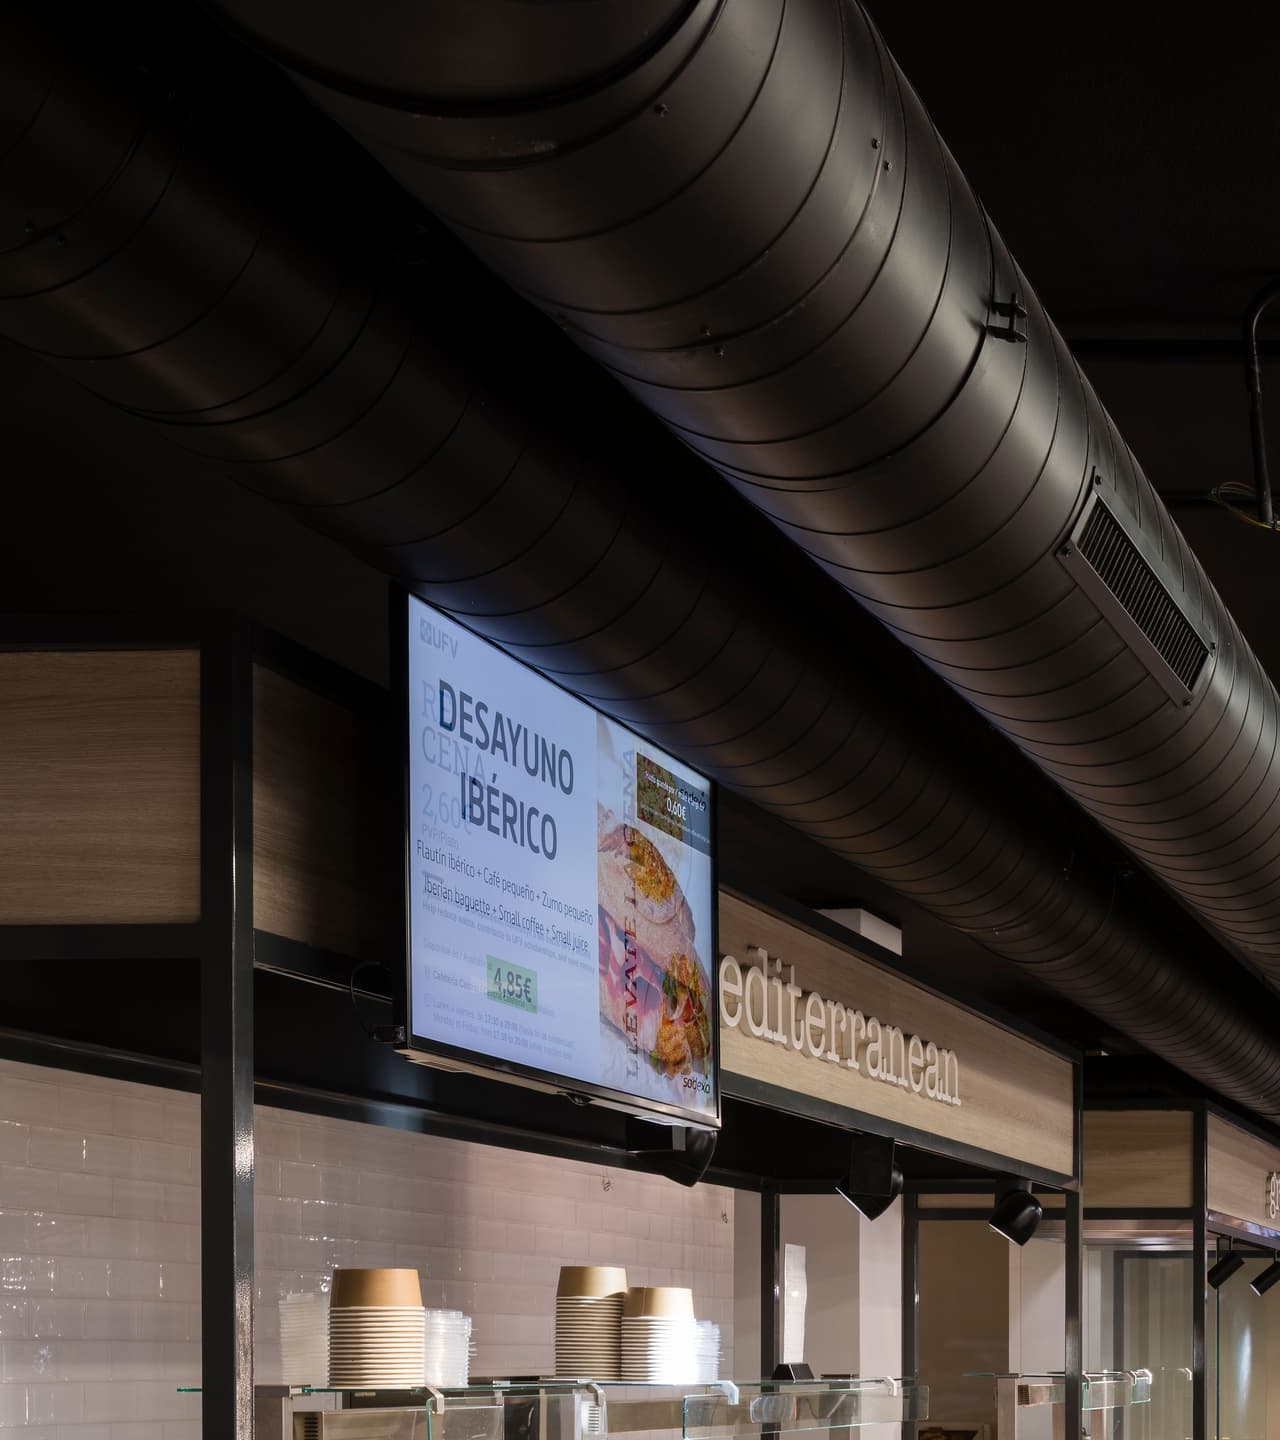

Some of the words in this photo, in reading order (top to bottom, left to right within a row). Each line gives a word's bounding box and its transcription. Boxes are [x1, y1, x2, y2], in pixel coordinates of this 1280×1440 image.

[432, 630, 459, 660] UFV
[439, 679, 574, 796] DESAYUNO
[460, 772, 558, 861] IBÉRICO
[416, 839, 447, 867] Flautín
[448, 852, 475, 879] ibérico
[482, 867, 501, 889] Café
[501, 878, 535, 903] pequeño
[541, 890, 563, 914] Zumo
[563, 901, 594, 926] pequeño
[423, 874, 453, 902] Iberian
[454, 886, 491, 917] baguette
[498, 904, 521, 928] Small
[521, 914, 545, 936] coffee
[551, 924, 572, 946] Small
[493, 967, 532, 1003] 4,85€
[719, 947, 962, 1106] editerranean
[683, 1075, 710, 1094] sodexo
